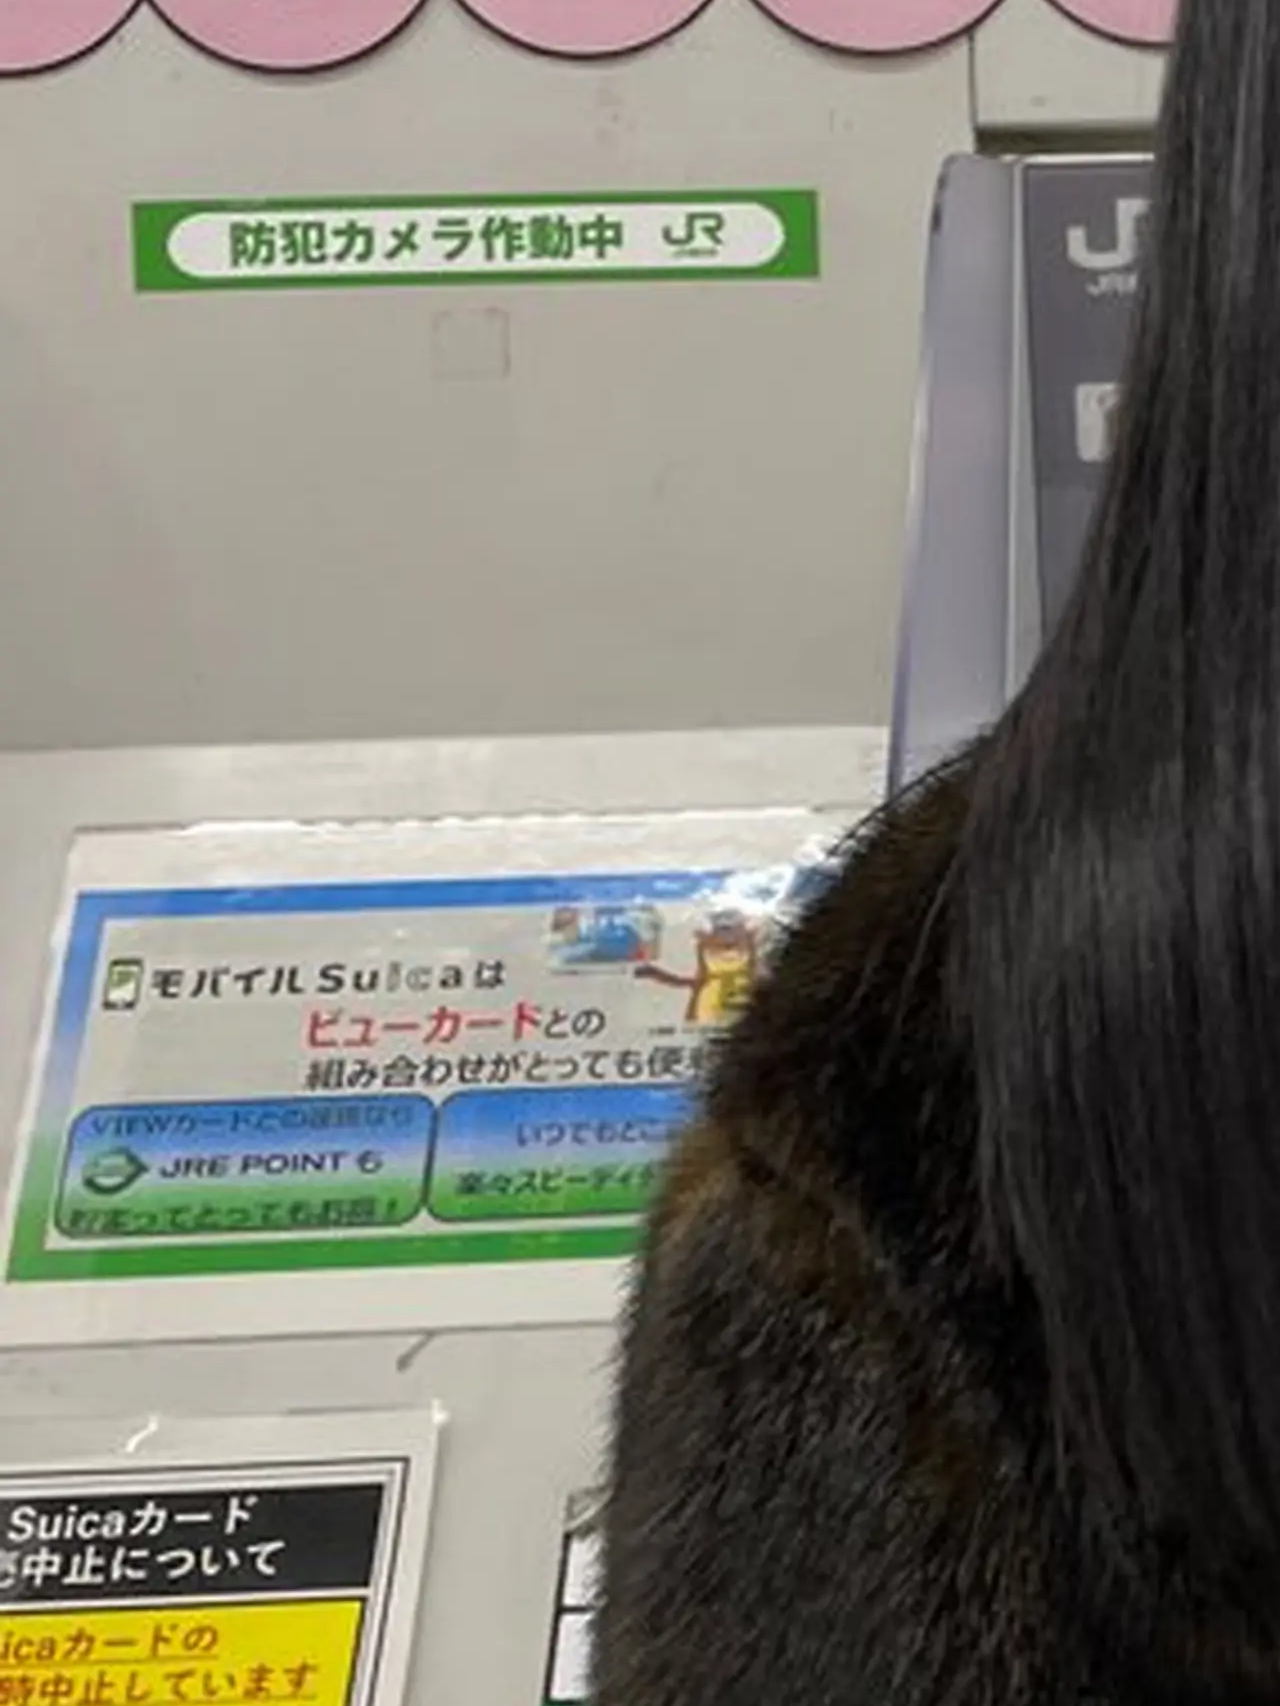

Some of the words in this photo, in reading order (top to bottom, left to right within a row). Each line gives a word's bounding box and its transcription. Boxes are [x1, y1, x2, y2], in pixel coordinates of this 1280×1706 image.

[229, 214, 625, 268] 防犯カメラ作動中
[661, 212, 725, 246] JR
[150, 959, 506, 1001] モバイルSuicaは
[308, 1001, 606, 1049] ビューカードとの
[159, 1155, 230, 1179] JRE
[238, 1151, 350, 1175] POINT
[7, 1496, 259, 1543] Suicaカード
